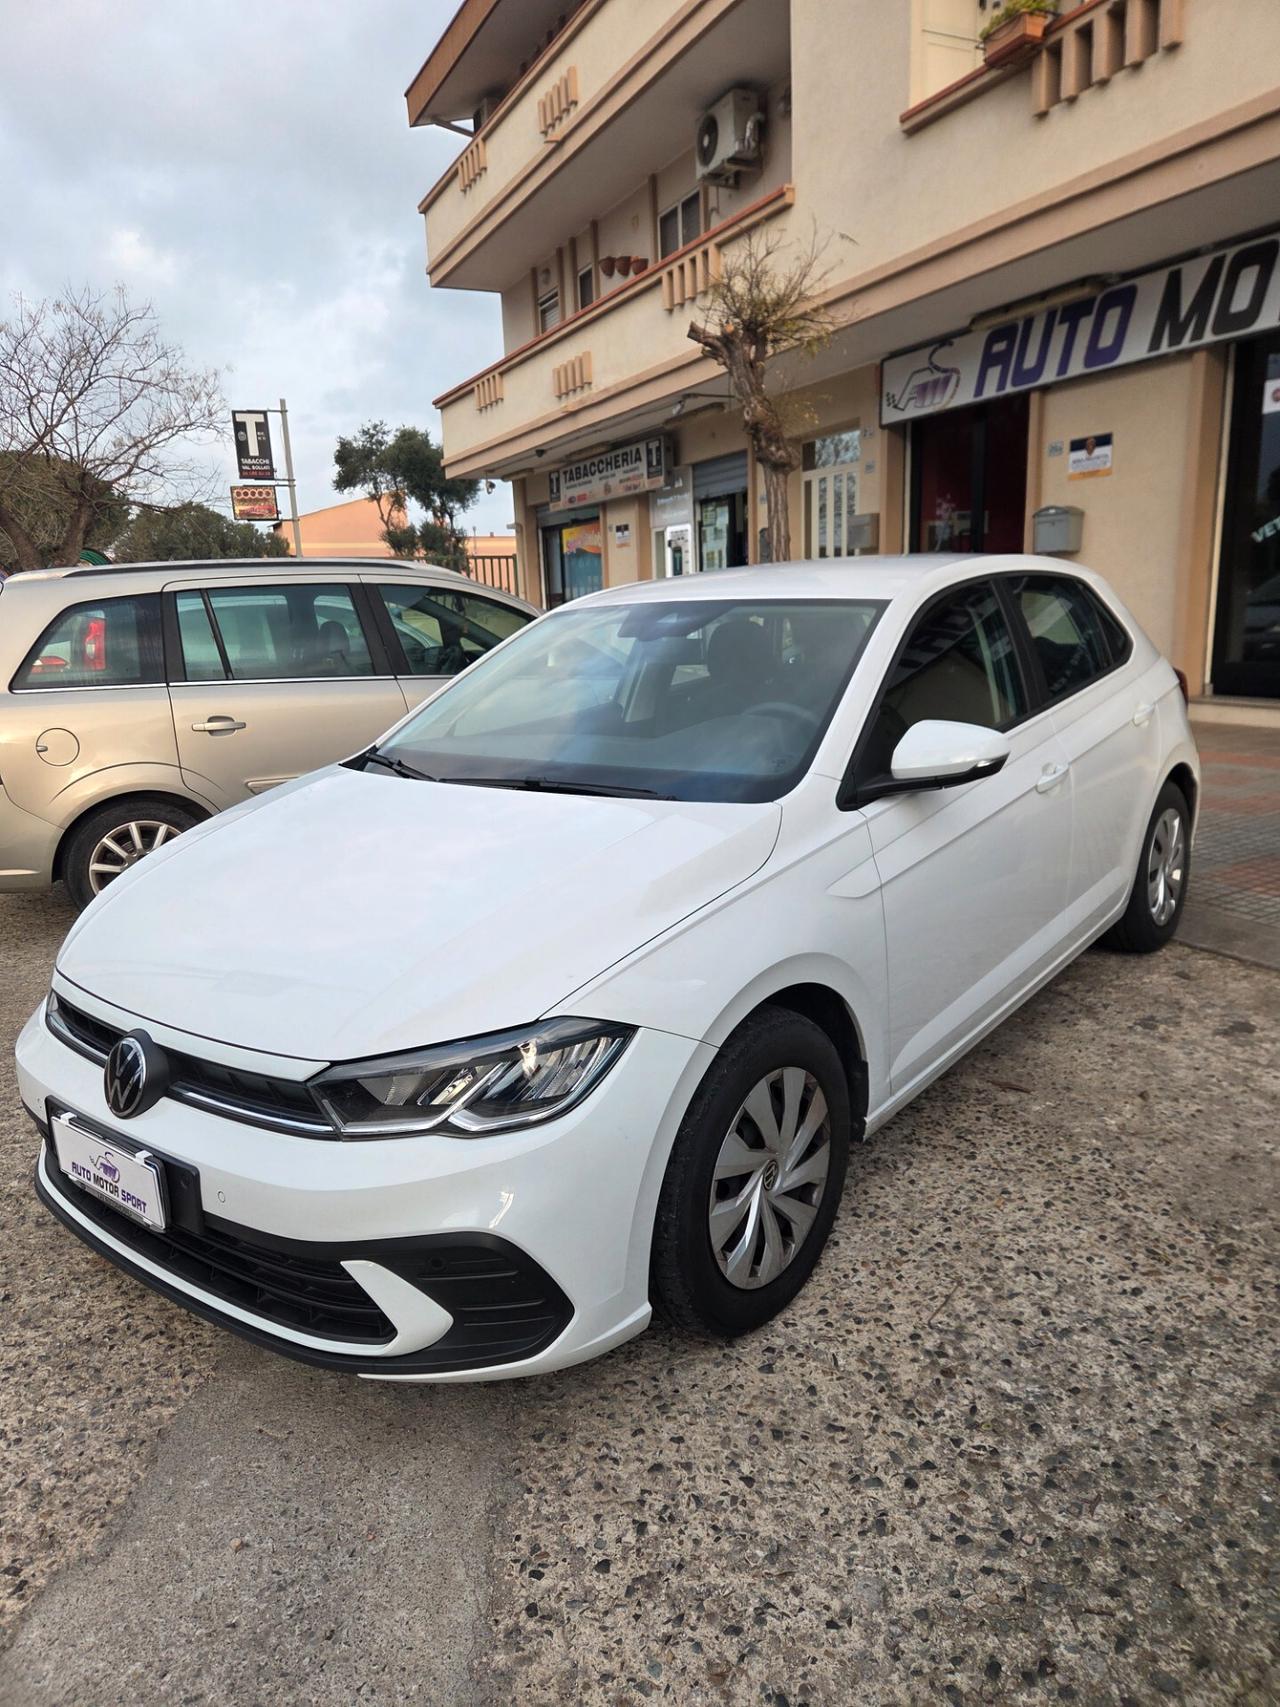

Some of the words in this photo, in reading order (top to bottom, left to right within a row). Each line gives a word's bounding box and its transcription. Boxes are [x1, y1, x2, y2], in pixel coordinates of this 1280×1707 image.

[973, 284, 1138, 398] AUTO
[1147, 239, 1280, 353] MO
[235, 413, 265, 456] T
[648, 440, 660, 466] T
[551, 471, 559, 496] T
[563, 447, 642, 482] TABACCHERIA
[71, 1162, 92, 1183] AUTO
[93, 1174, 120, 1198] MOTOR
[121, 1189, 147, 1214] SPORT
